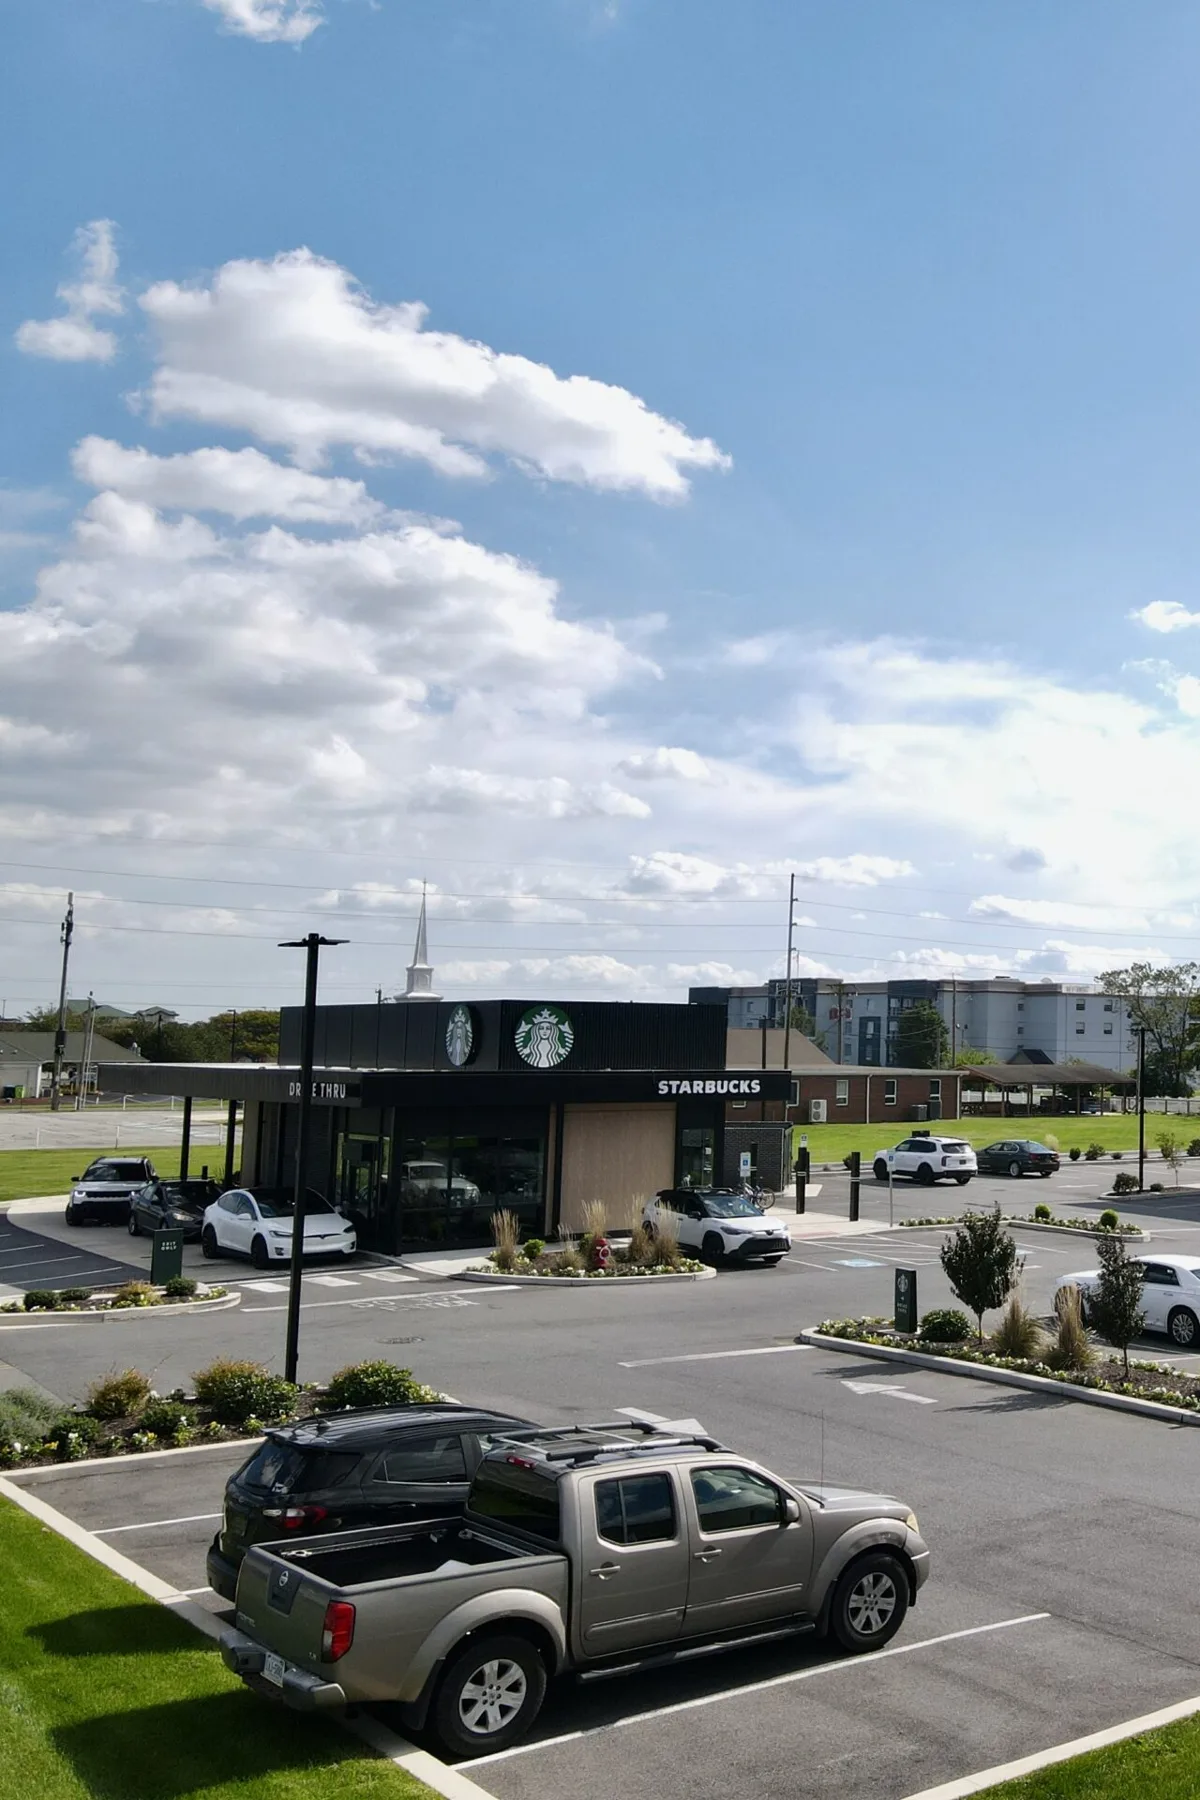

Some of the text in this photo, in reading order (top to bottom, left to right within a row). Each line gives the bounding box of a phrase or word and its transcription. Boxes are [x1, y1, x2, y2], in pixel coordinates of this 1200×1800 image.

[289, 1082, 346, 1099] DRE THRU
[658, 1080, 761, 1095] STARBUCKS
